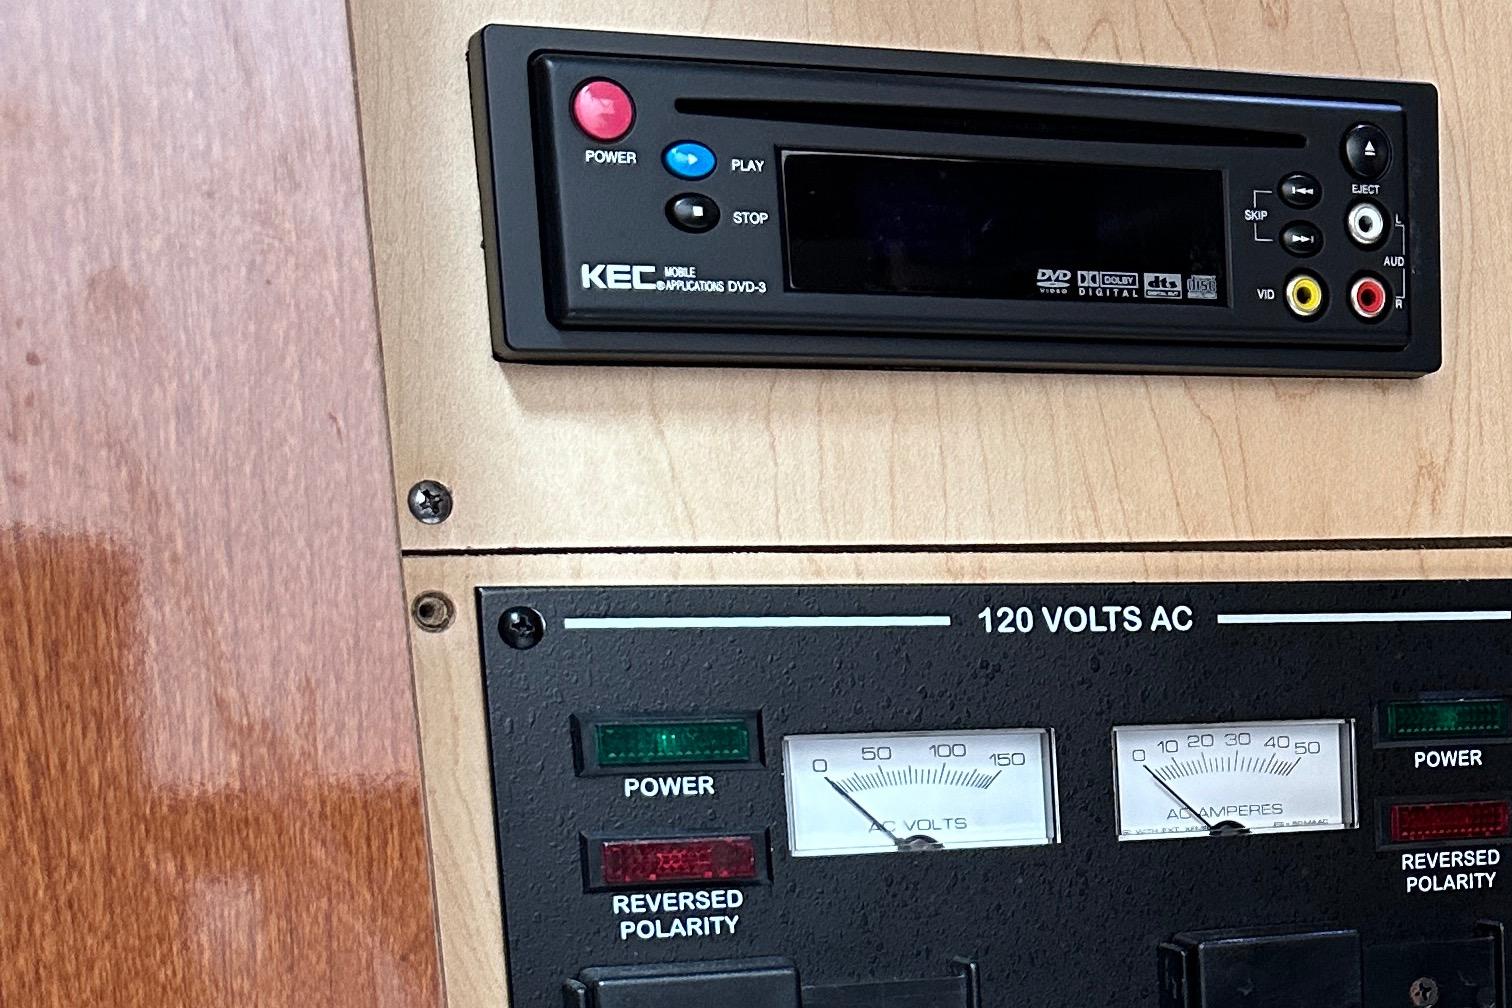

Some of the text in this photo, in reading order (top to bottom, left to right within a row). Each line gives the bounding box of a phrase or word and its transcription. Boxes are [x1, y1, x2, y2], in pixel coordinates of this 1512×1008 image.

[585, 150, 637, 164] POWER
[731, 159, 764, 172] PLAY
[1352, 184, 1380, 194] EJECT
[733, 211, 768, 224] STOP
[1244, 209, 1268, 221] SKIP
[1383, 256, 1405, 267] AUD
[581, 263, 696, 290] KEC MOBILE
[1037, 269, 1072, 281] DVD
[728, 281, 767, 293] DVD-3
[1078, 287, 1139, 298] DIGITAL
[1256, 289, 1275, 300] VID
[978, 605, 1194, 633] 120 VOLTS AC
[1187, 734, 1214, 747] 20
[1224, 732, 1251, 746] 30
[1264, 735, 1290, 749] 40
[861, 746, 892, 761] 50
[929, 744, 967, 758] 100
[1157, 740, 1178, 753] 10
[1294, 741, 1321, 754] 50
[988, 752, 1026, 767] 150
[1132, 749, 1146, 762] 0
[1414, 749, 1483, 768] POWER
[812, 758, 828, 773] 0
[624, 775, 715, 797] POWER
[1200, 803, 1283, 818] AMPERES
[903, 818, 967, 831] VOLTS
[1402, 849, 1500, 870] REVERSED
[1406, 872, 1497, 893] POLARITY
[613, 889, 743, 914] REVERSED
[620, 915, 739, 940] POLARITY
